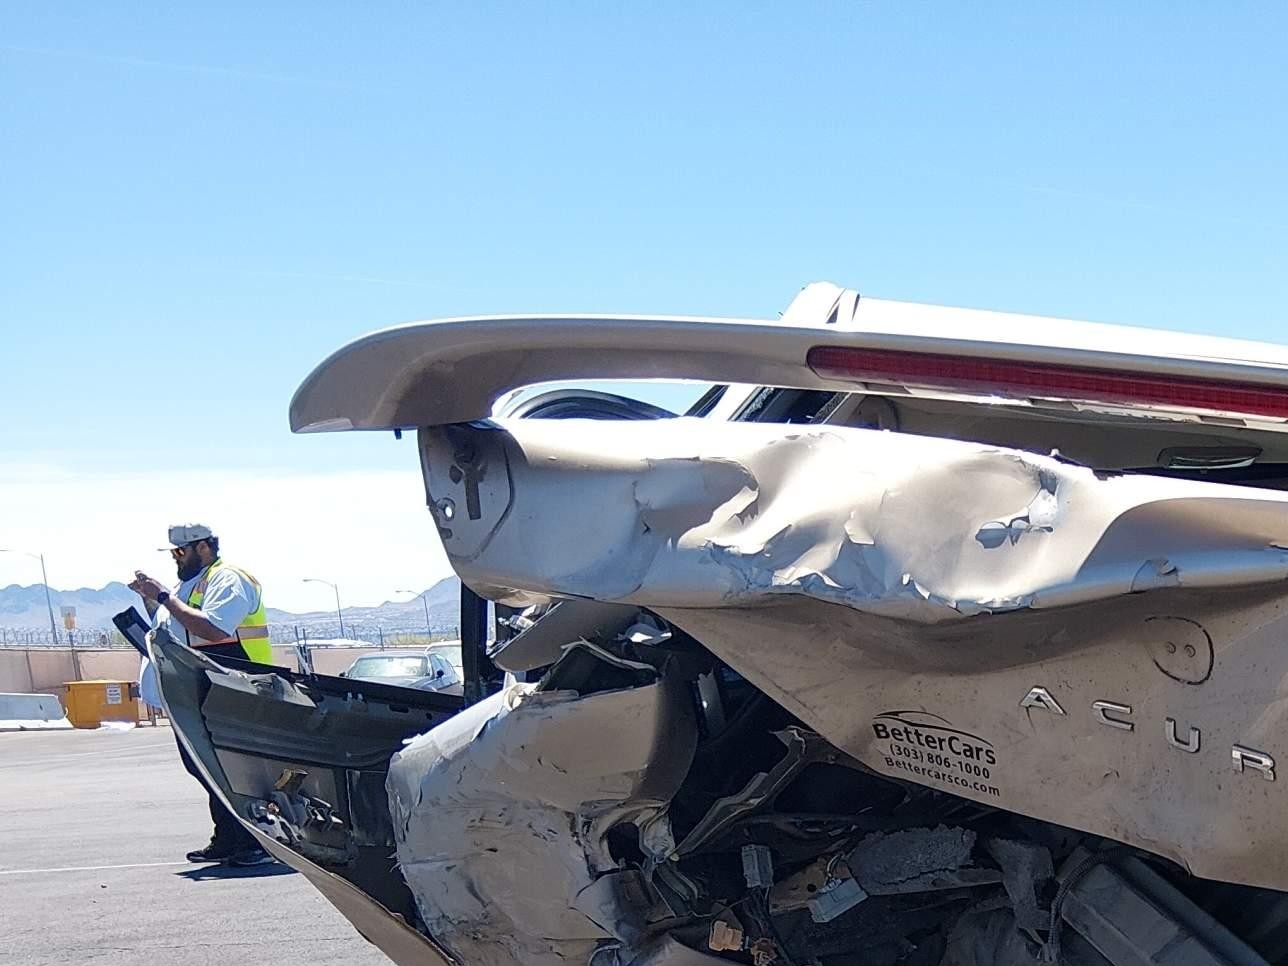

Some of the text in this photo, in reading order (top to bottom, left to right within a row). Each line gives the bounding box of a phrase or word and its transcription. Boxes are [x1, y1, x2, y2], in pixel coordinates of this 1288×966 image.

[872, 723, 996, 764] BetterCars
[890, 744, 990, 779] (303) 806-1000
[884, 757, 1000, 796] Bettercarsco.com
